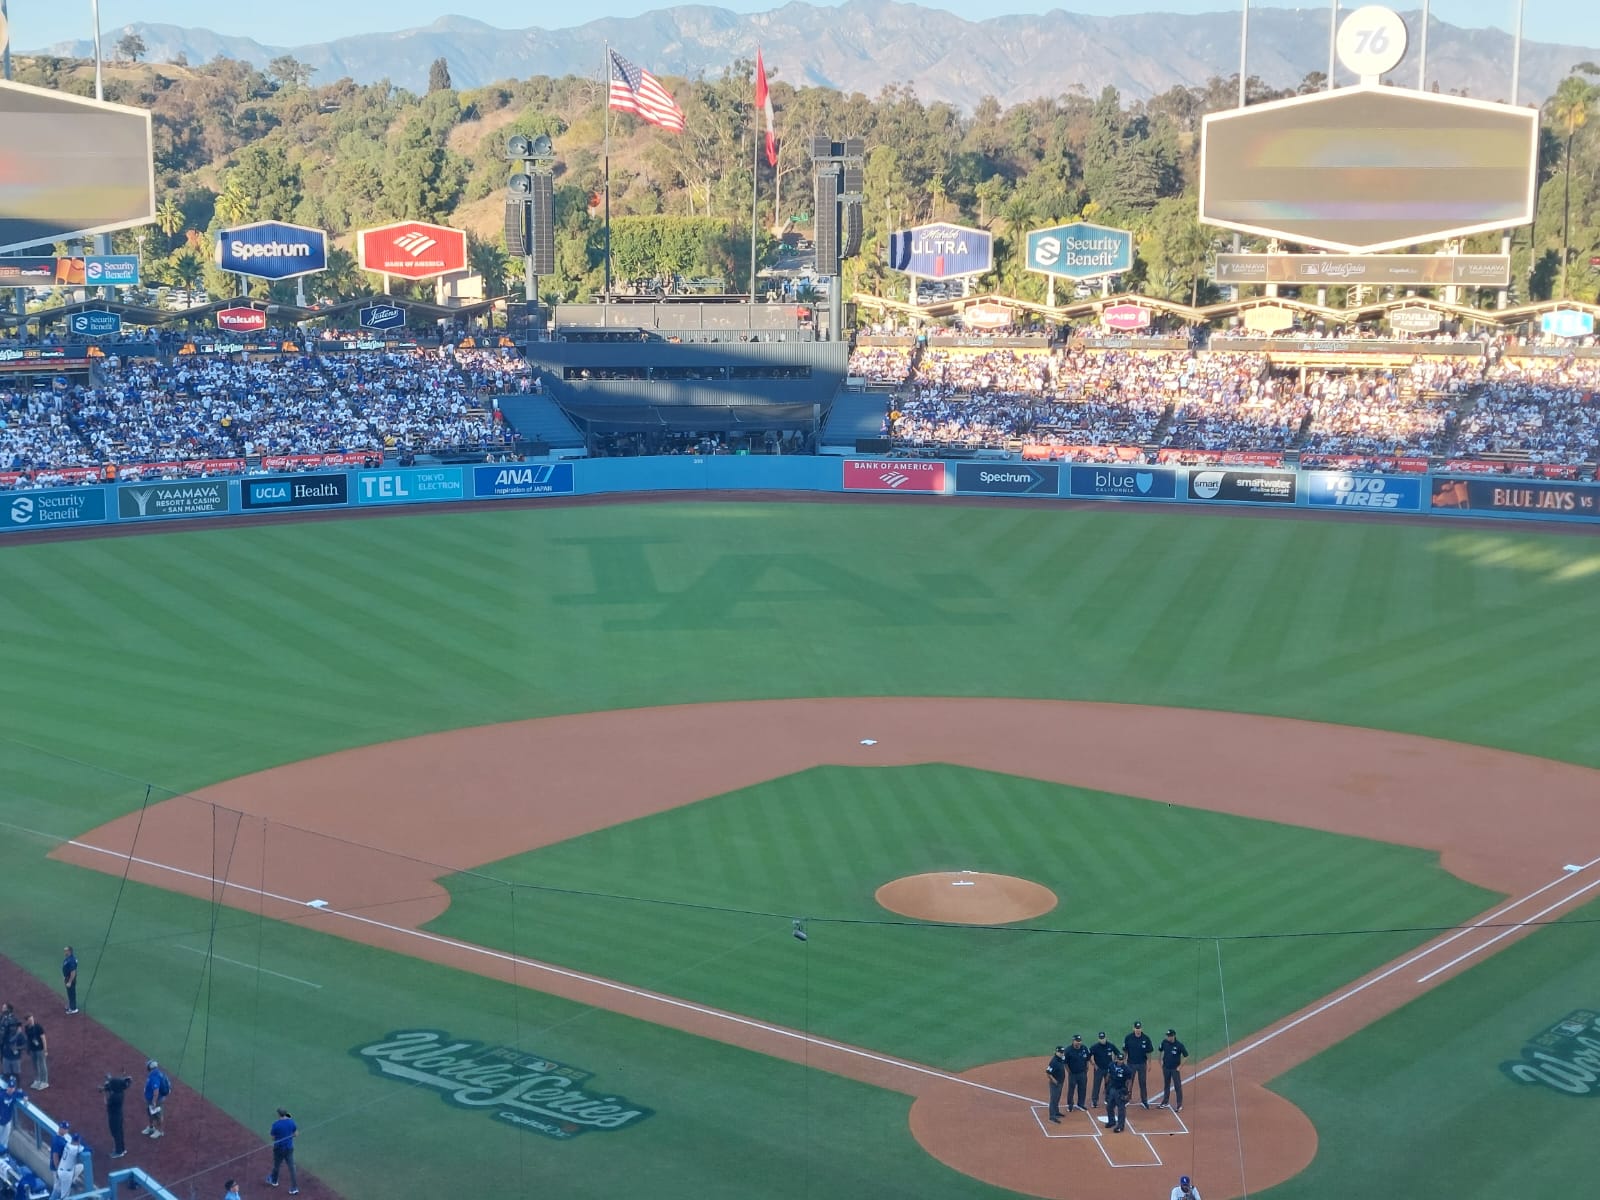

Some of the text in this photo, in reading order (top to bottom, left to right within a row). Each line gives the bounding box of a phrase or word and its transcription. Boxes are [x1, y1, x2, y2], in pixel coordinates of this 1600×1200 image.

[1354, 26, 1389, 54] 76
[231, 240, 310, 260] Spectrum
[911, 240, 968, 254] ULTRA
[1066, 236, 1121, 254] Security
[1066, 252, 1114, 265] Benefit
[104, 262, 135, 273] Security
[105, 270, 132, 279] Benefit
[90, 316, 116, 326] Security
[221, 315, 262, 323] Yakult
[367, 309, 399, 326] Jostens
[1393, 312, 1438, 320] STARLUX
[894, 463, 934, 471] AMERICA
[495, 469, 533, 485] ANA
[980, 472, 1031, 483] Spectrum
[1095, 472, 1135, 487] blue
[1195, 480, 1219, 488] smart
[1237, 479, 1291, 488] smartwater
[255, 483, 339, 499] UCLA Health
[361, 476, 409, 498] TEL
[418, 481, 460, 490] ELECTRON
[1326, 477, 1385, 493] TOYO
[38, 494, 85, 508] Security
[193, 497, 221, 505] CASINO
[1334, 491, 1400, 507] TIRES
[1494, 488, 1593, 510] BLUE JAYS VS
[40, 507, 80, 521] Benefit
[185, 504, 215, 512] MANUEL
[360, 1032, 541, 1090] World
[452, 1073, 643, 1128] Series
